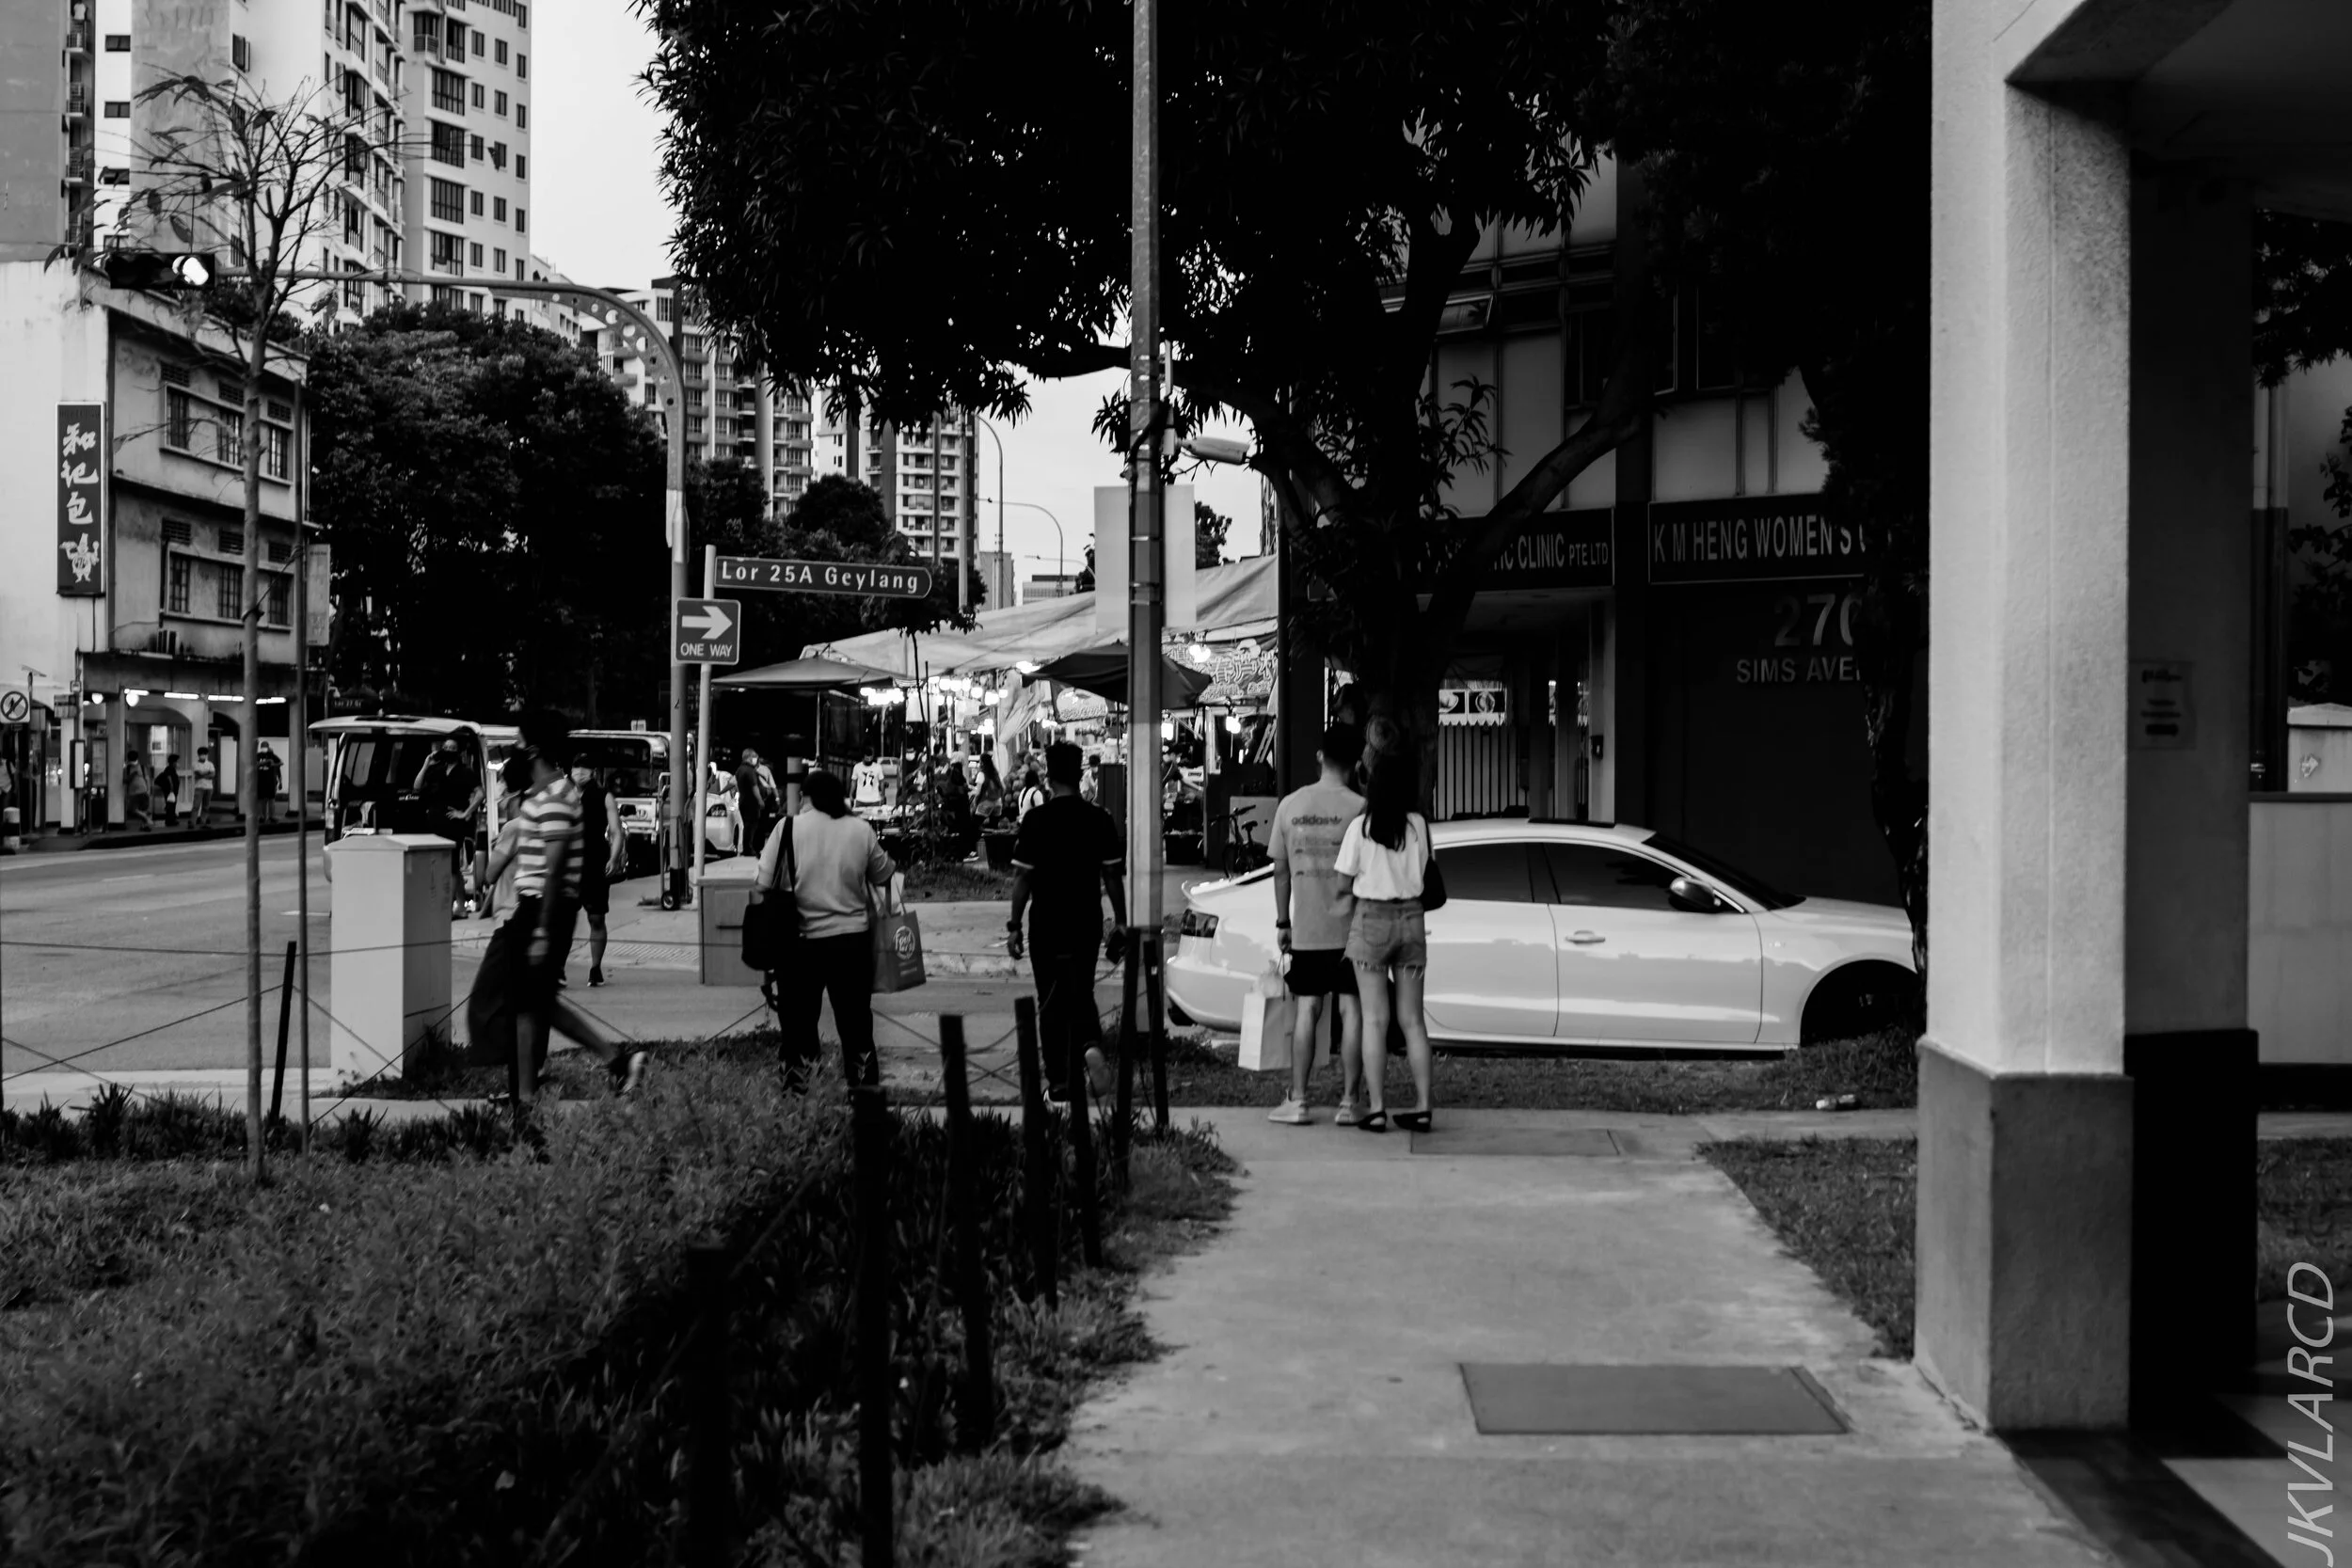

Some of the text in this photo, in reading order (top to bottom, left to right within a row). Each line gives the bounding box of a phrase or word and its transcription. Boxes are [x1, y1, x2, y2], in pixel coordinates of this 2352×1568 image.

[1517, 531, 1565, 570] CLINIC
[1568, 542, 1588, 565] PTE
[1589, 542, 1609, 564] LTD
[1654, 523, 1666, 562] K
[1672, 522, 1686, 562] M
[1692, 518, 1748, 561] HENG
[1754, 514, 1852, 558] WOMENS
[722, 561, 918, 594] Lor 25A Geylang
[680, 642, 733, 657] ONE WAY
[1736, 657, 1797, 684] SIMS
[1291, 815, 1329, 826] adidas
